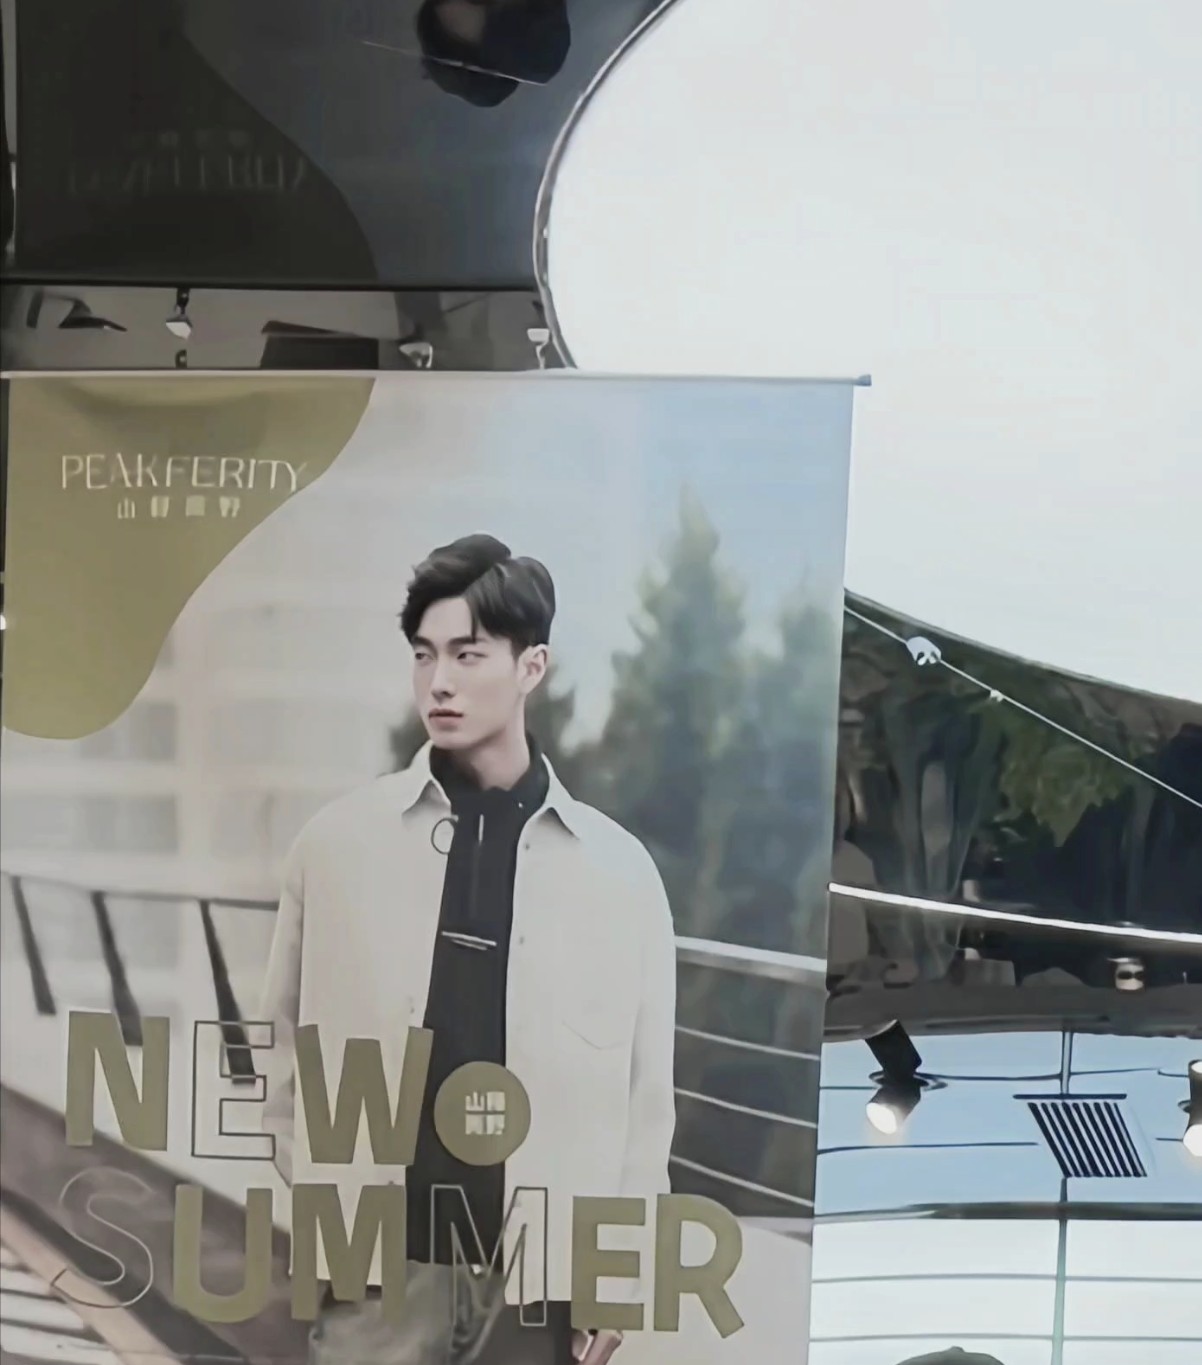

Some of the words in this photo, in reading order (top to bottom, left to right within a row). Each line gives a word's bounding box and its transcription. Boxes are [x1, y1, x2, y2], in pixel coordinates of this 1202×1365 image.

[62, 452, 307, 492] PEAKFERITY
[65, 1010, 434, 1166] NEW
[50, 1168, 745, 1339] SUMMER
